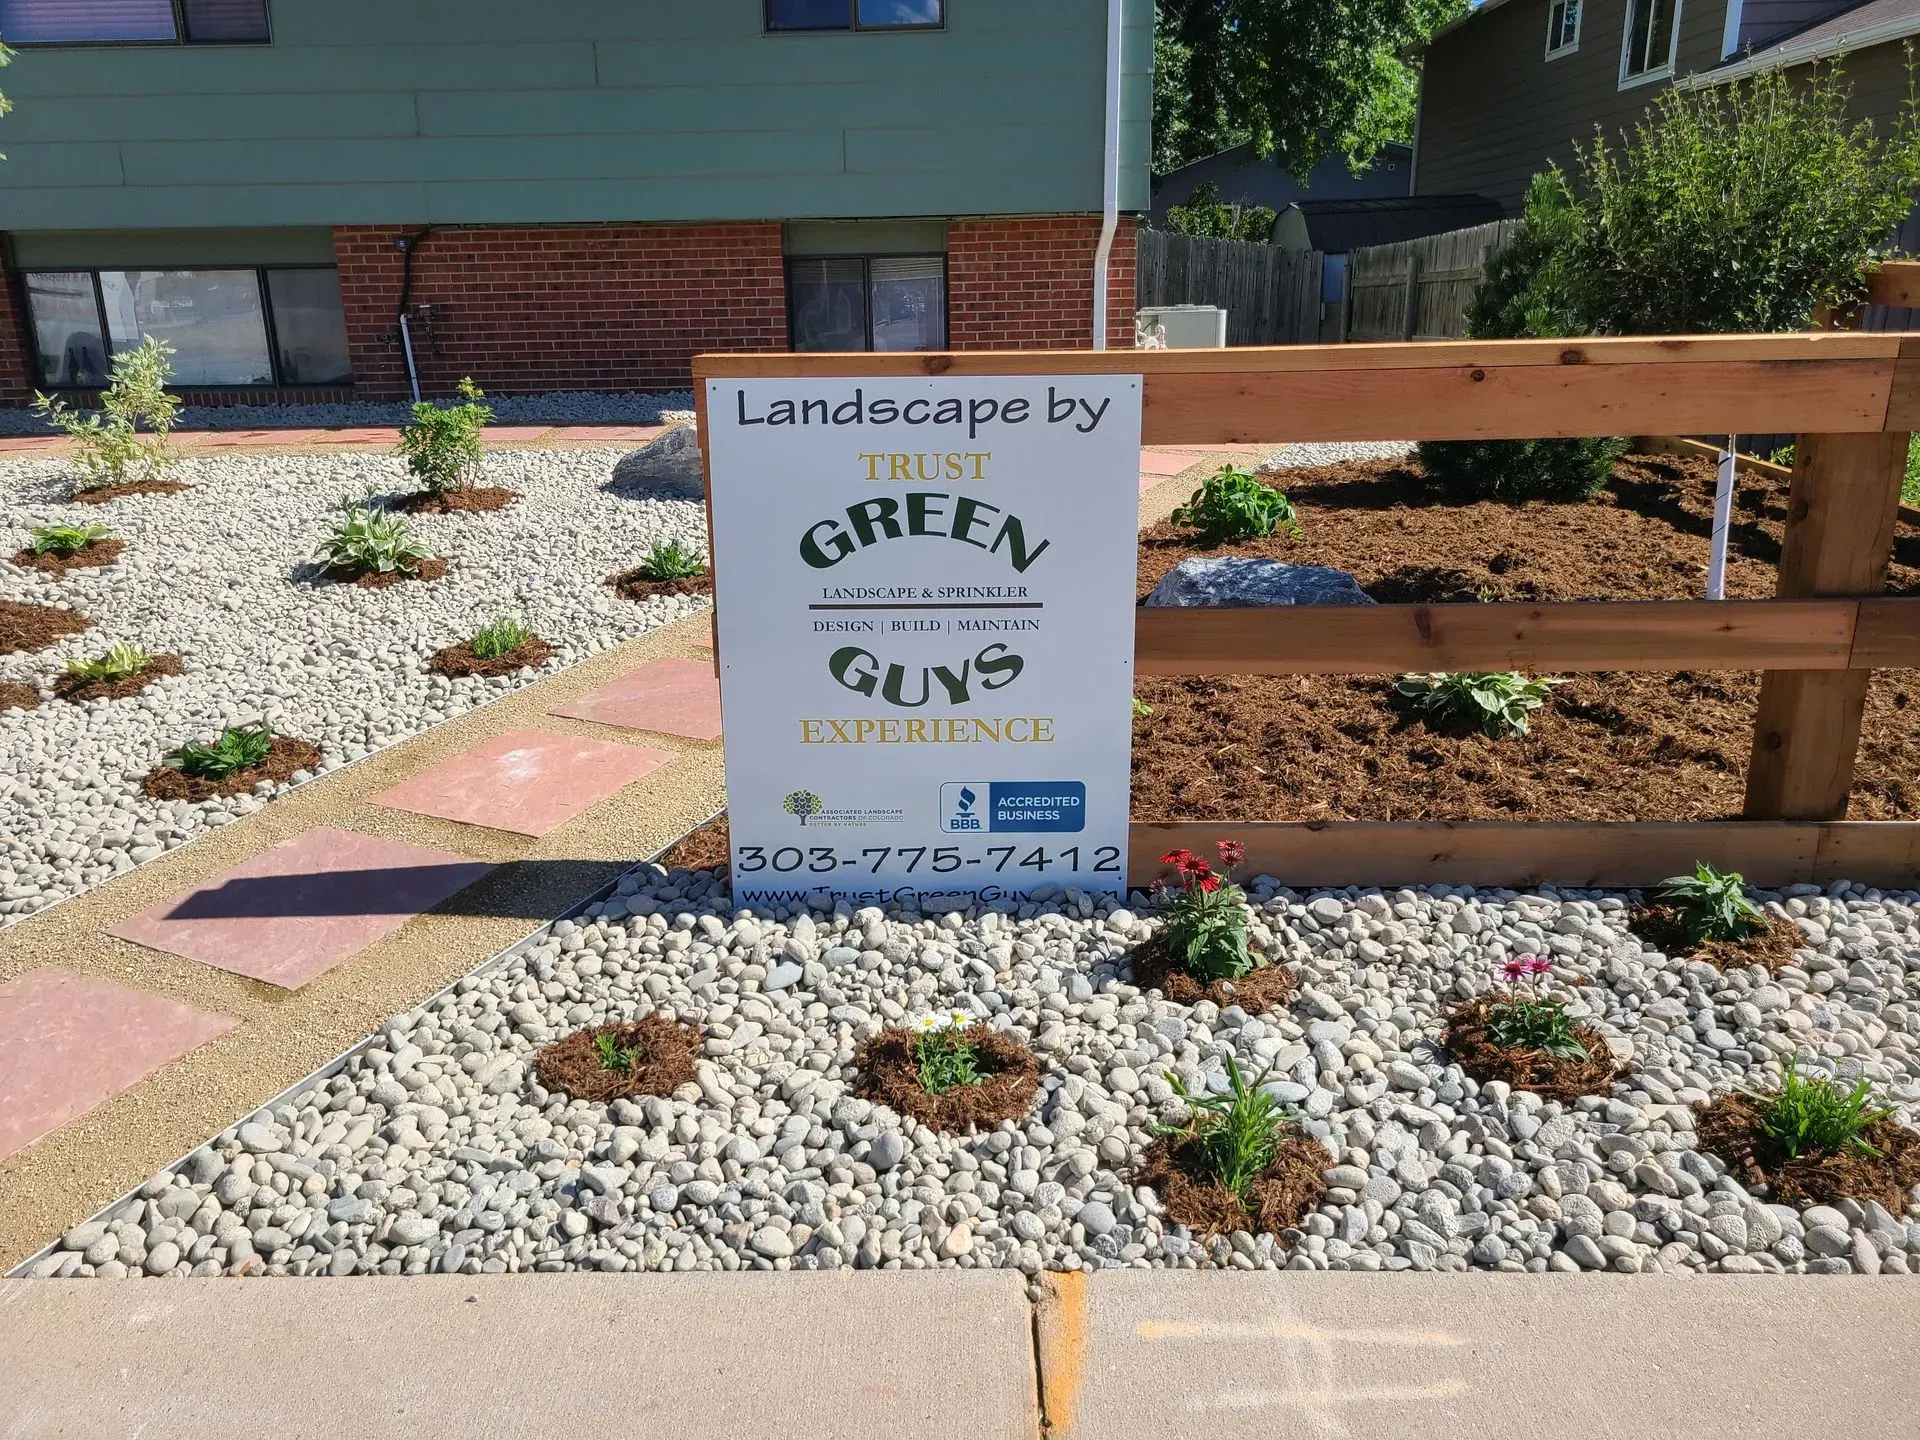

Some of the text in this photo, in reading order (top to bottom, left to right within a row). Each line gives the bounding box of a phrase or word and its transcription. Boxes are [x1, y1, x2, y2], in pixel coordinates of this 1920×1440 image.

[738, 386, 1111, 439] Landscape by
[858, 452, 991, 480] TRUST
[799, 492, 1051, 574] GREEN
[822, 586, 1028, 599] LANDSCAPE & SPRINKLER
[813, 619, 1040, 632] DESIGN BUILD MAINTAIN
[829, 642, 1025, 707] GUYS
[799, 717, 1055, 744] EXPERIENCE
[997, 796, 1080, 807] ACCREDITED
[997, 810, 1061, 821] BUSINESS
[737, 846, 1121, 874] 303-775-7412
